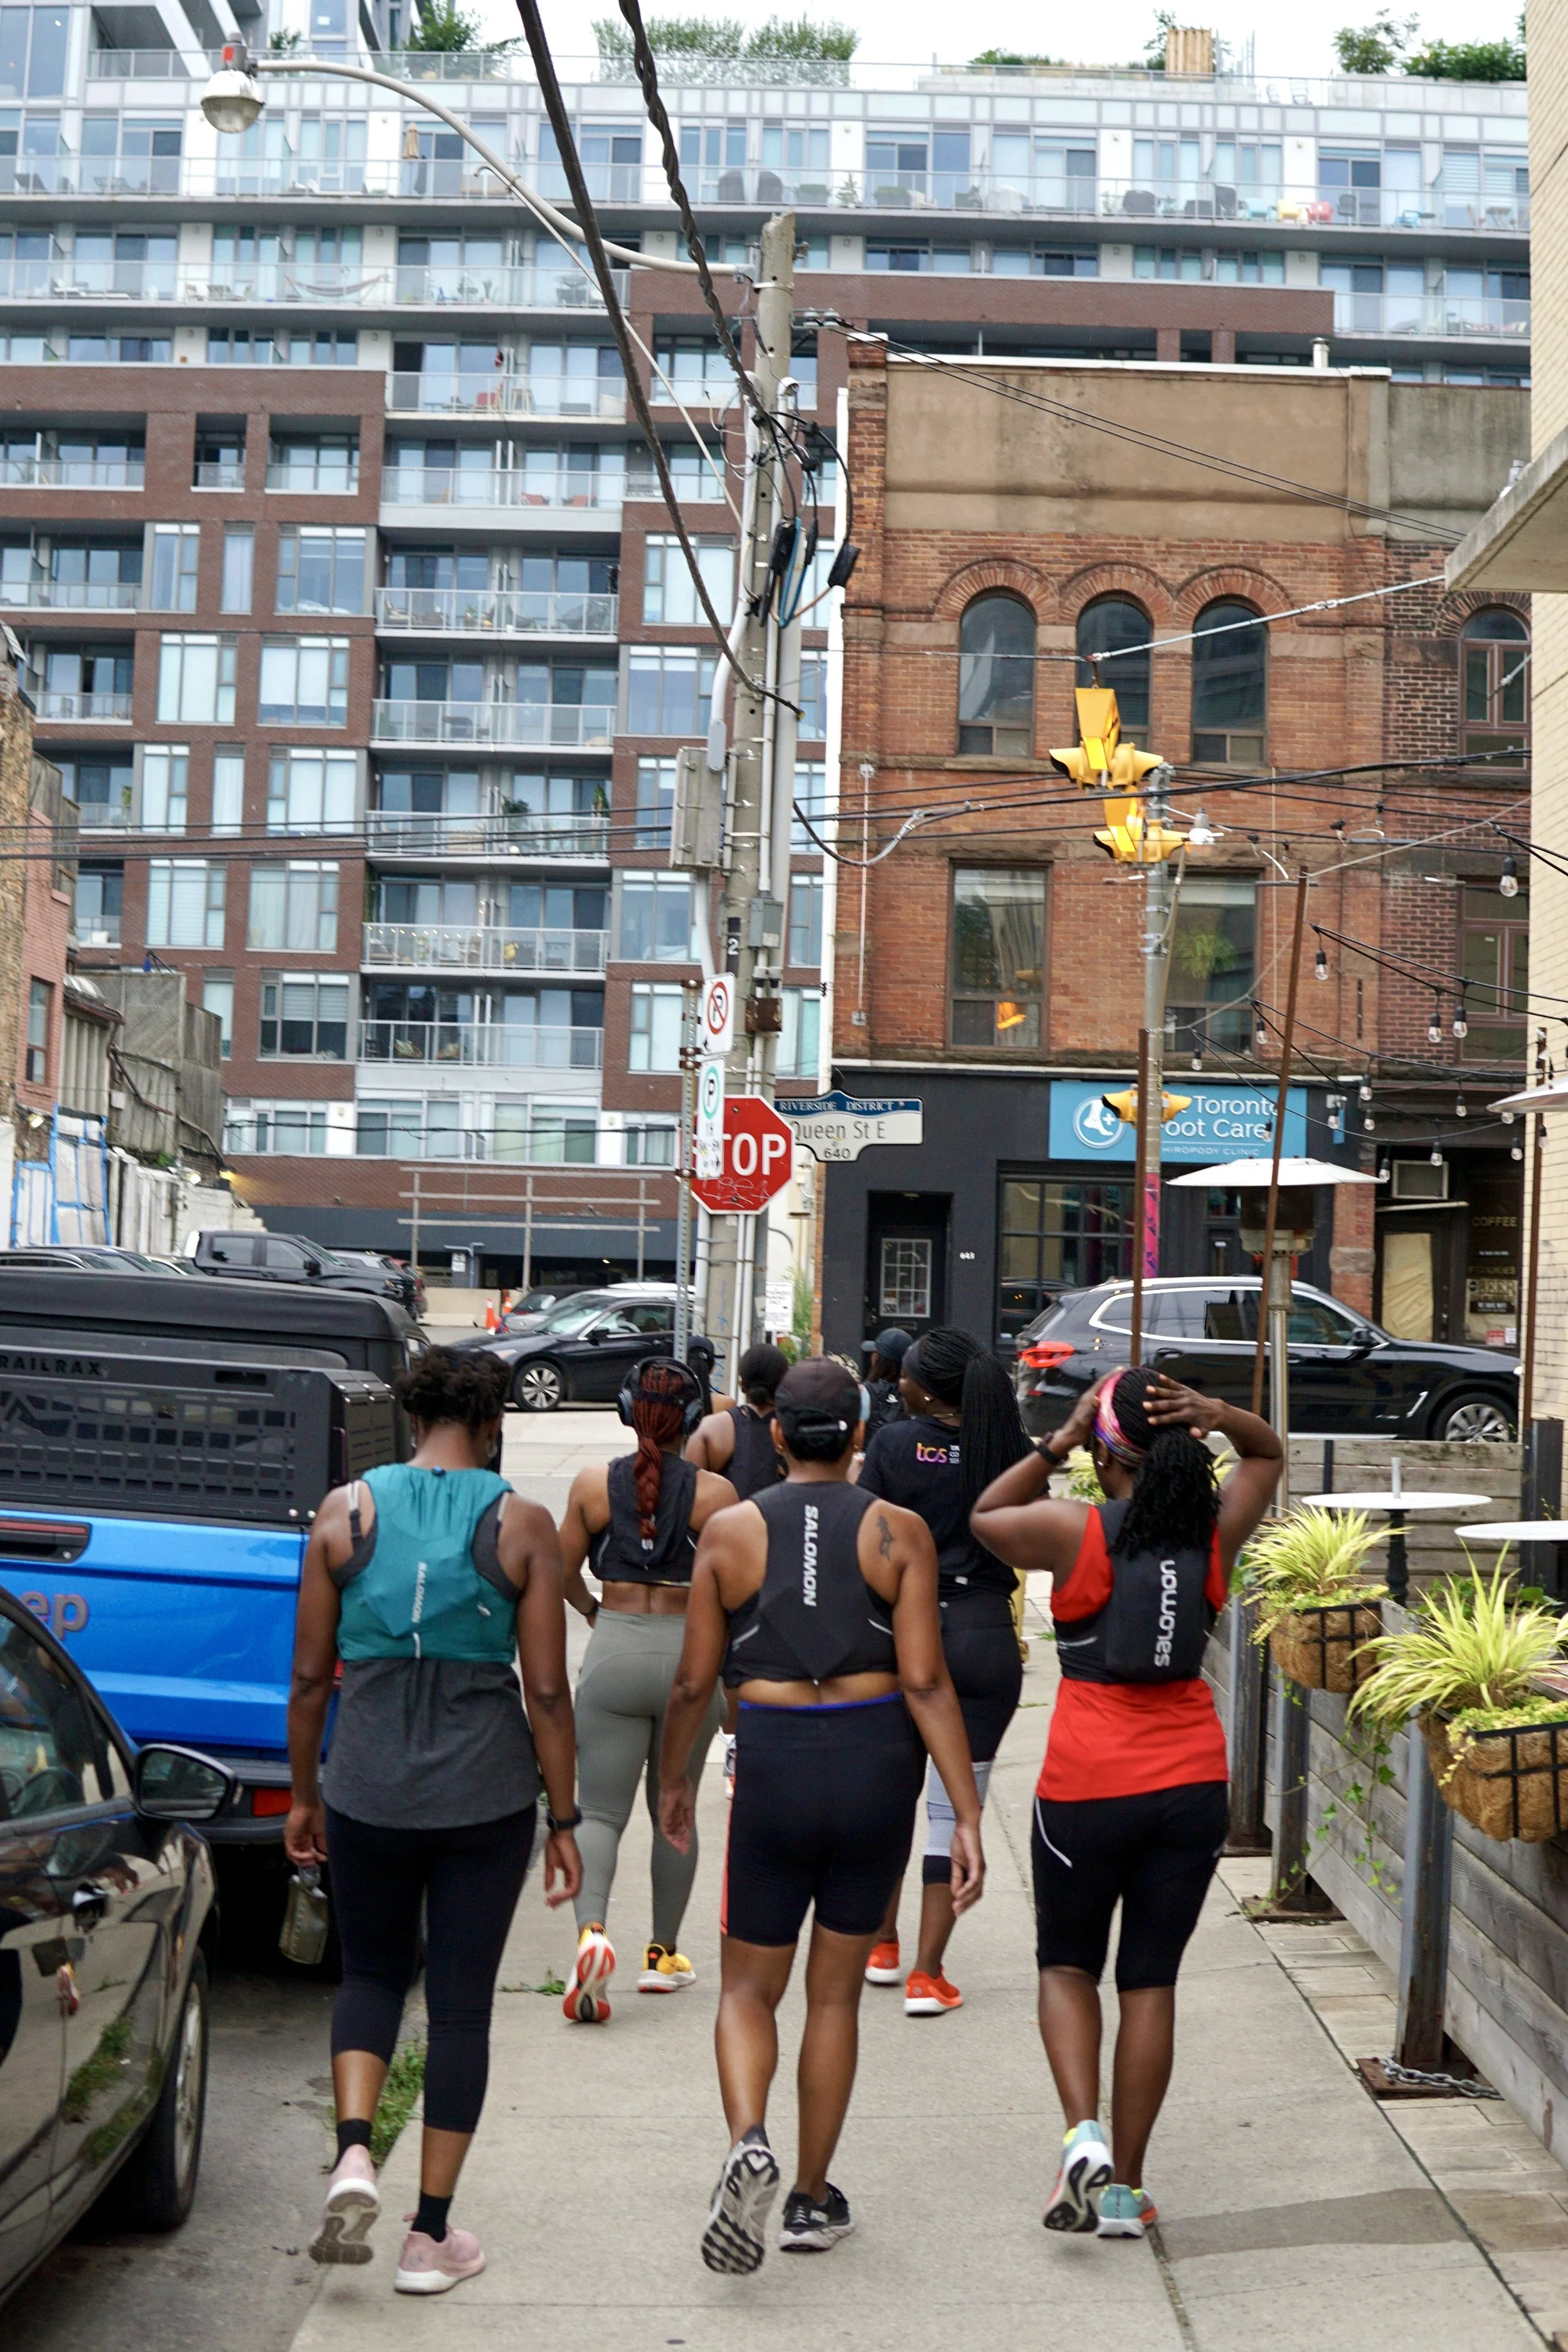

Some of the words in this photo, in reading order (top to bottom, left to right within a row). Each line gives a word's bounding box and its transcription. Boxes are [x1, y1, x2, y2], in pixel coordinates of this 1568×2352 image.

[728, 938, 739, 955] 2
[780, 1101, 836, 1111] RIVERSIDE
[846, 1101, 893, 1111] DISTRICT
[789, 1121, 846, 1142] Queen
[853, 1121, 871, 1139] St
[877, 1121, 886, 1139] E
[1161, 1118, 1206, 1137] oot
[1213, 1119, 1267, 1138] Care
[824, 1148, 850, 1159] 640
[1162, 1147, 1221, 1155] HIROPODY
[1223, 1147, 1260, 1156] CLINIC
[1473, 1216, 1518, 1227] COFFEE
[803, 1504, 819, 1607] SALOMON
[411, 1561, 428, 1623] SALOMON
